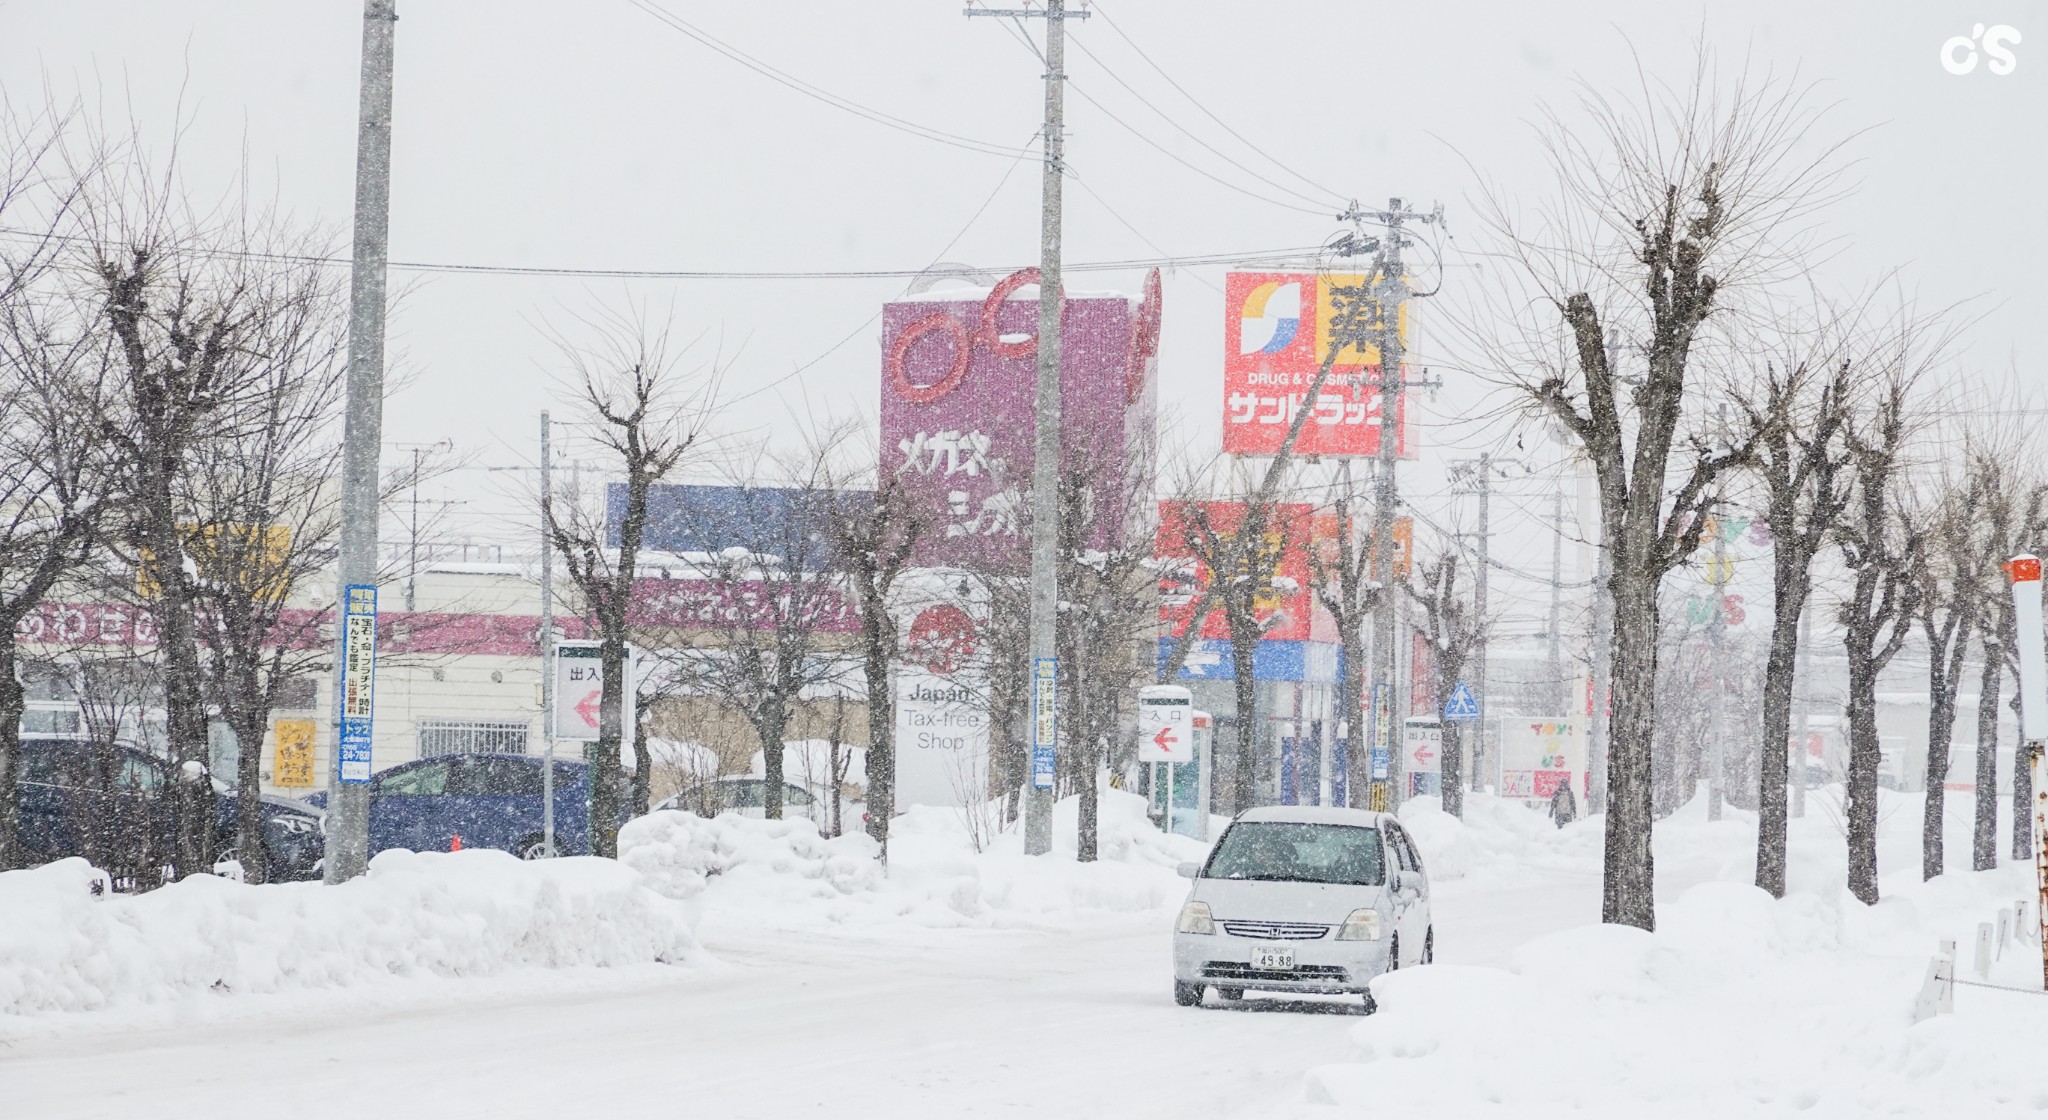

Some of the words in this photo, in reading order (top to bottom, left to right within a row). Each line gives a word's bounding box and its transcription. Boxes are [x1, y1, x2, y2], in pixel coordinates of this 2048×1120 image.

[1248, 373, 1288, 385] DRUG
[1293, 373, 1301, 385] &
[1307, 373, 1380, 385] CSMTC
[1687, 594, 1745, 625] US
[570, 667, 600, 681] 出入
[904, 709, 979, 727] Tax-free
[1151, 710, 1181, 720] 入口
[917, 732, 964, 752] Shop
[1408, 731, 1440, 741] 出入口
